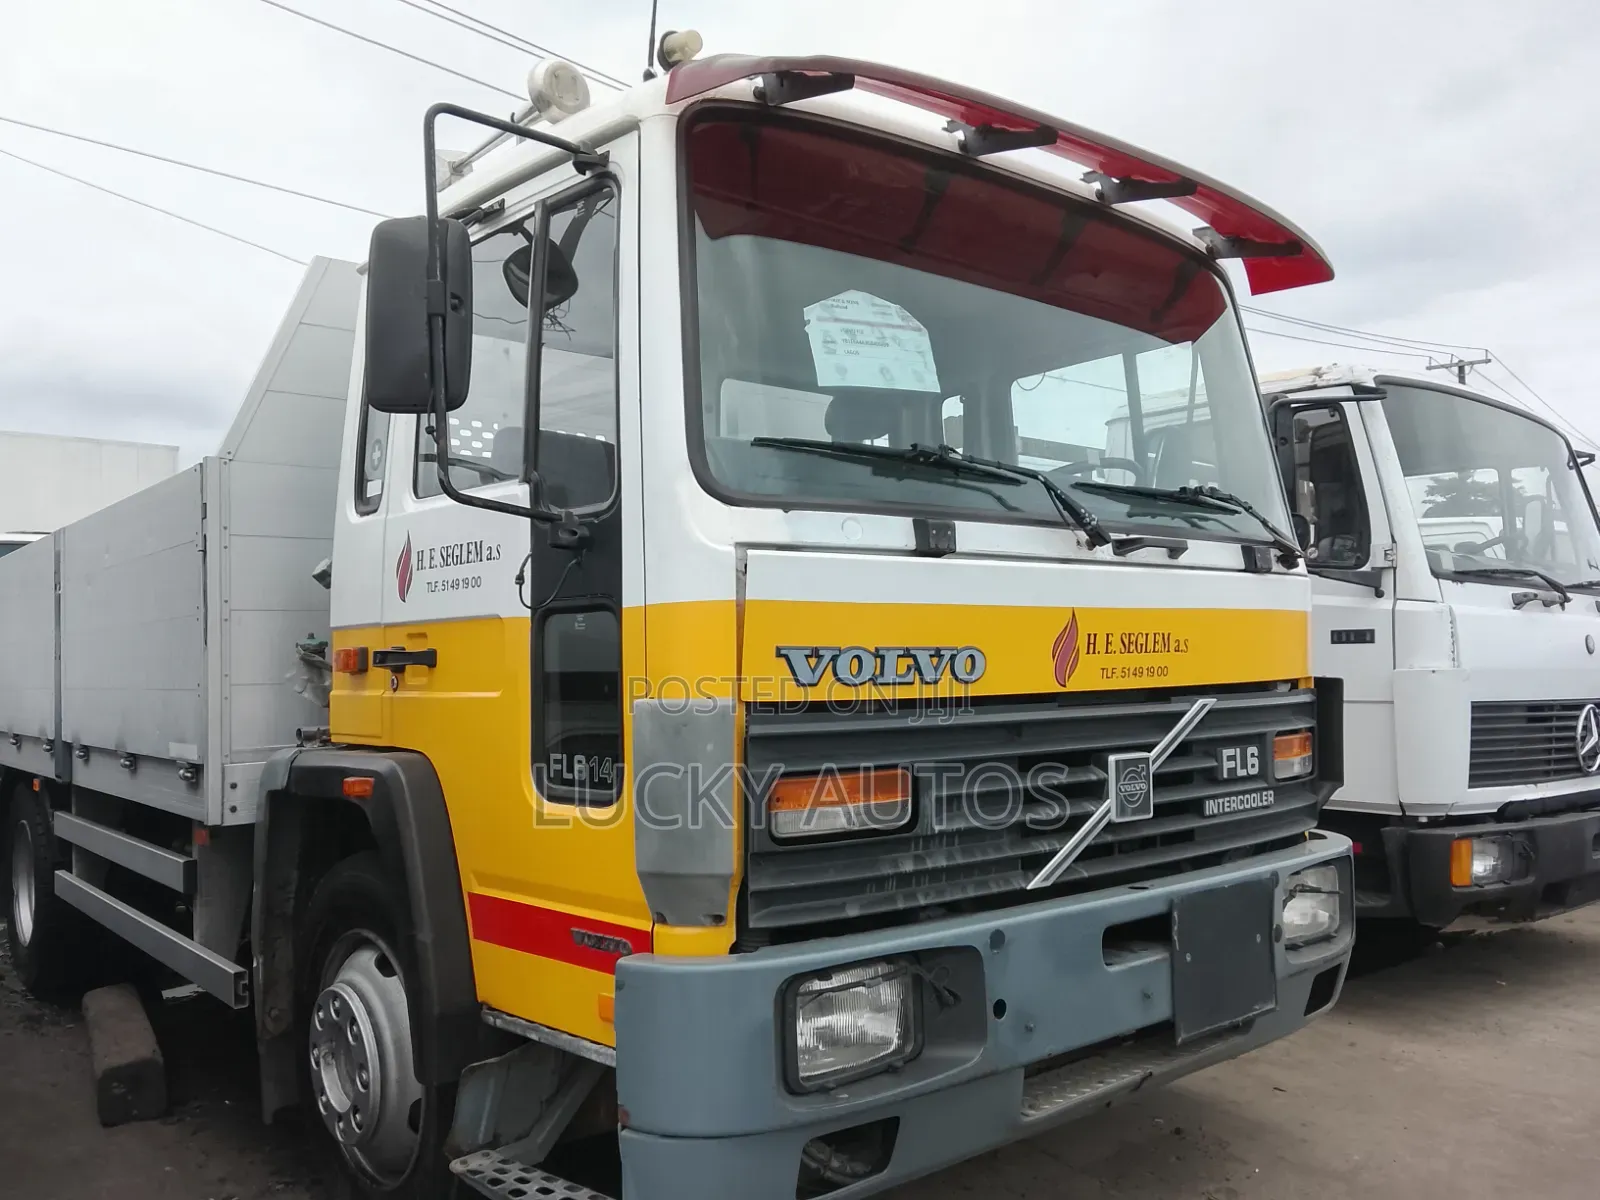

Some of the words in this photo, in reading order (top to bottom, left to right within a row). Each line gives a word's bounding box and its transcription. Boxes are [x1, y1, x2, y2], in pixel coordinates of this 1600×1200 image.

[416, 550, 426, 571] H.
[428, 548, 438, 570] E.
[439, 540, 484, 568] SEGLEM
[486, 543, 502, 561] a.s
[426, 581, 440, 593] TLF.
[470, 575, 482, 588] 00
[1085, 633, 1100, 655] H.
[1104, 632, 1117, 655] E.
[1119, 631, 1172, 654] SEGLEM
[1174, 638, 1189, 654] a.s
[776, 645, 987, 687] VOLVO
[1100, 667, 1119, 680] TLF.
[1156, 665, 1169, 677] 00
[1221, 746, 1259, 779] FL6
[1117, 783, 1147, 794] VOLVO
[1203, 790, 1275, 817] INTERCOOLER
